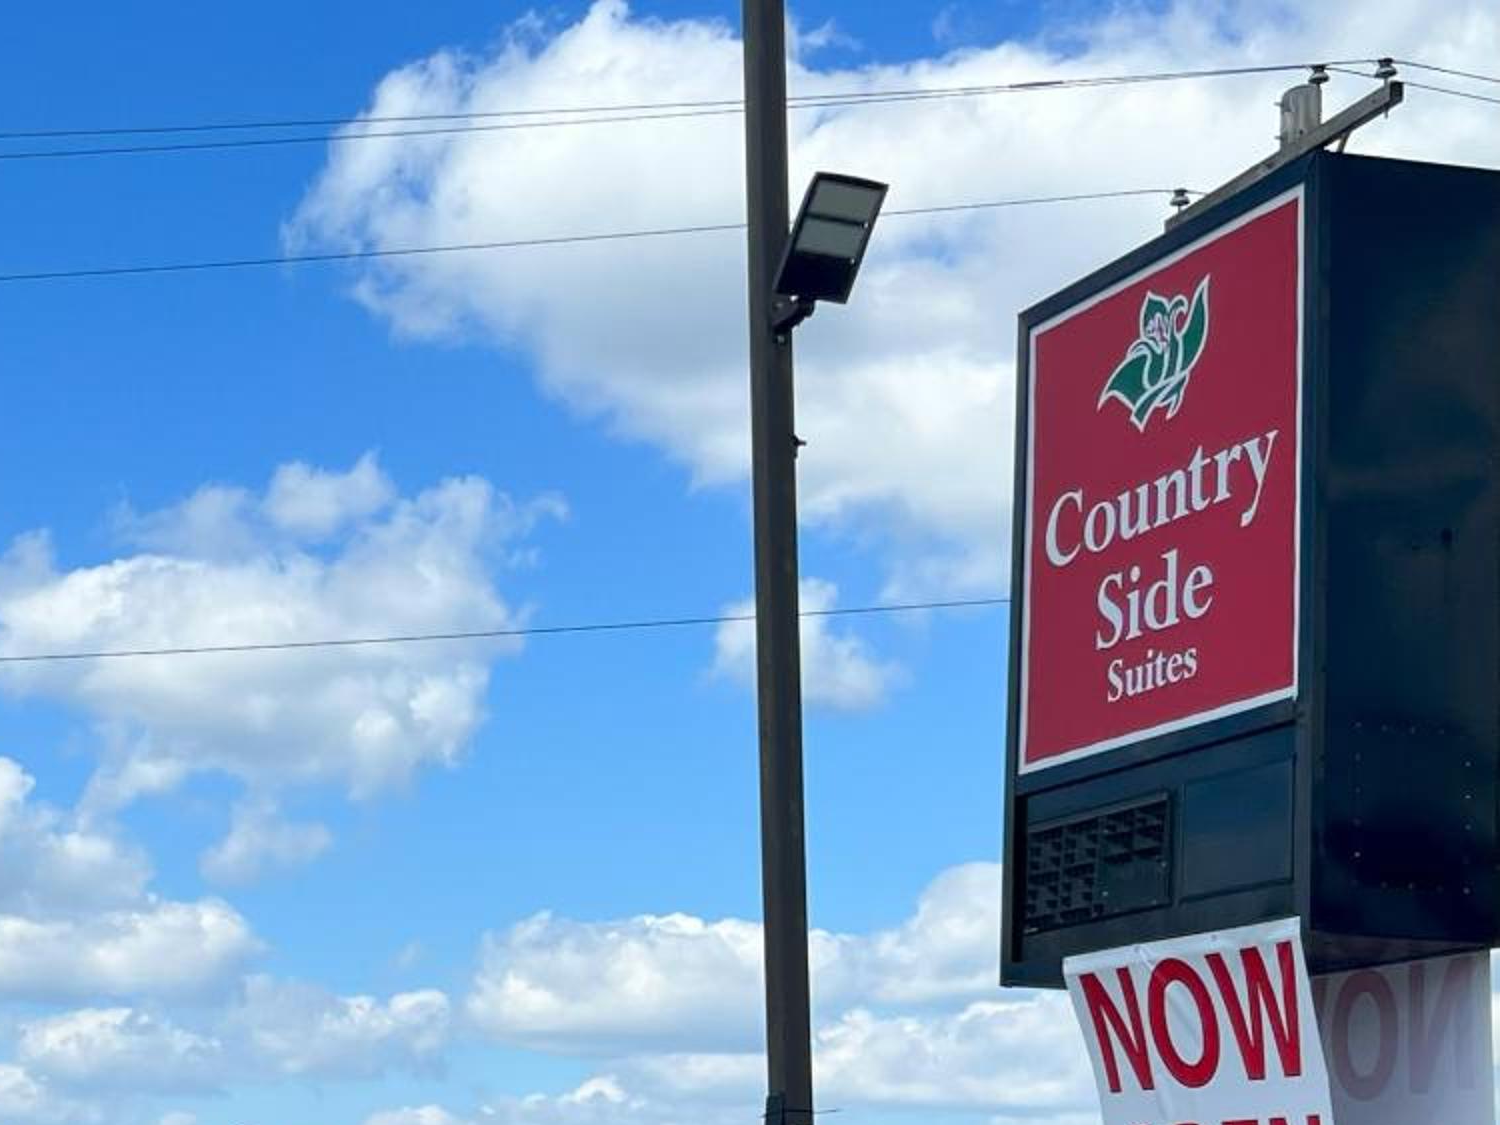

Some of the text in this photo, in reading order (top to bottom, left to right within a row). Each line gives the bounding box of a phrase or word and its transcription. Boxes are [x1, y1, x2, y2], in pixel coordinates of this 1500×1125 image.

[1044, 430, 1279, 567] Country
[1095, 549, 1214, 651] Side
[1107, 647, 1198, 703] Suites
[1078, 940, 1302, 1093] NOW
